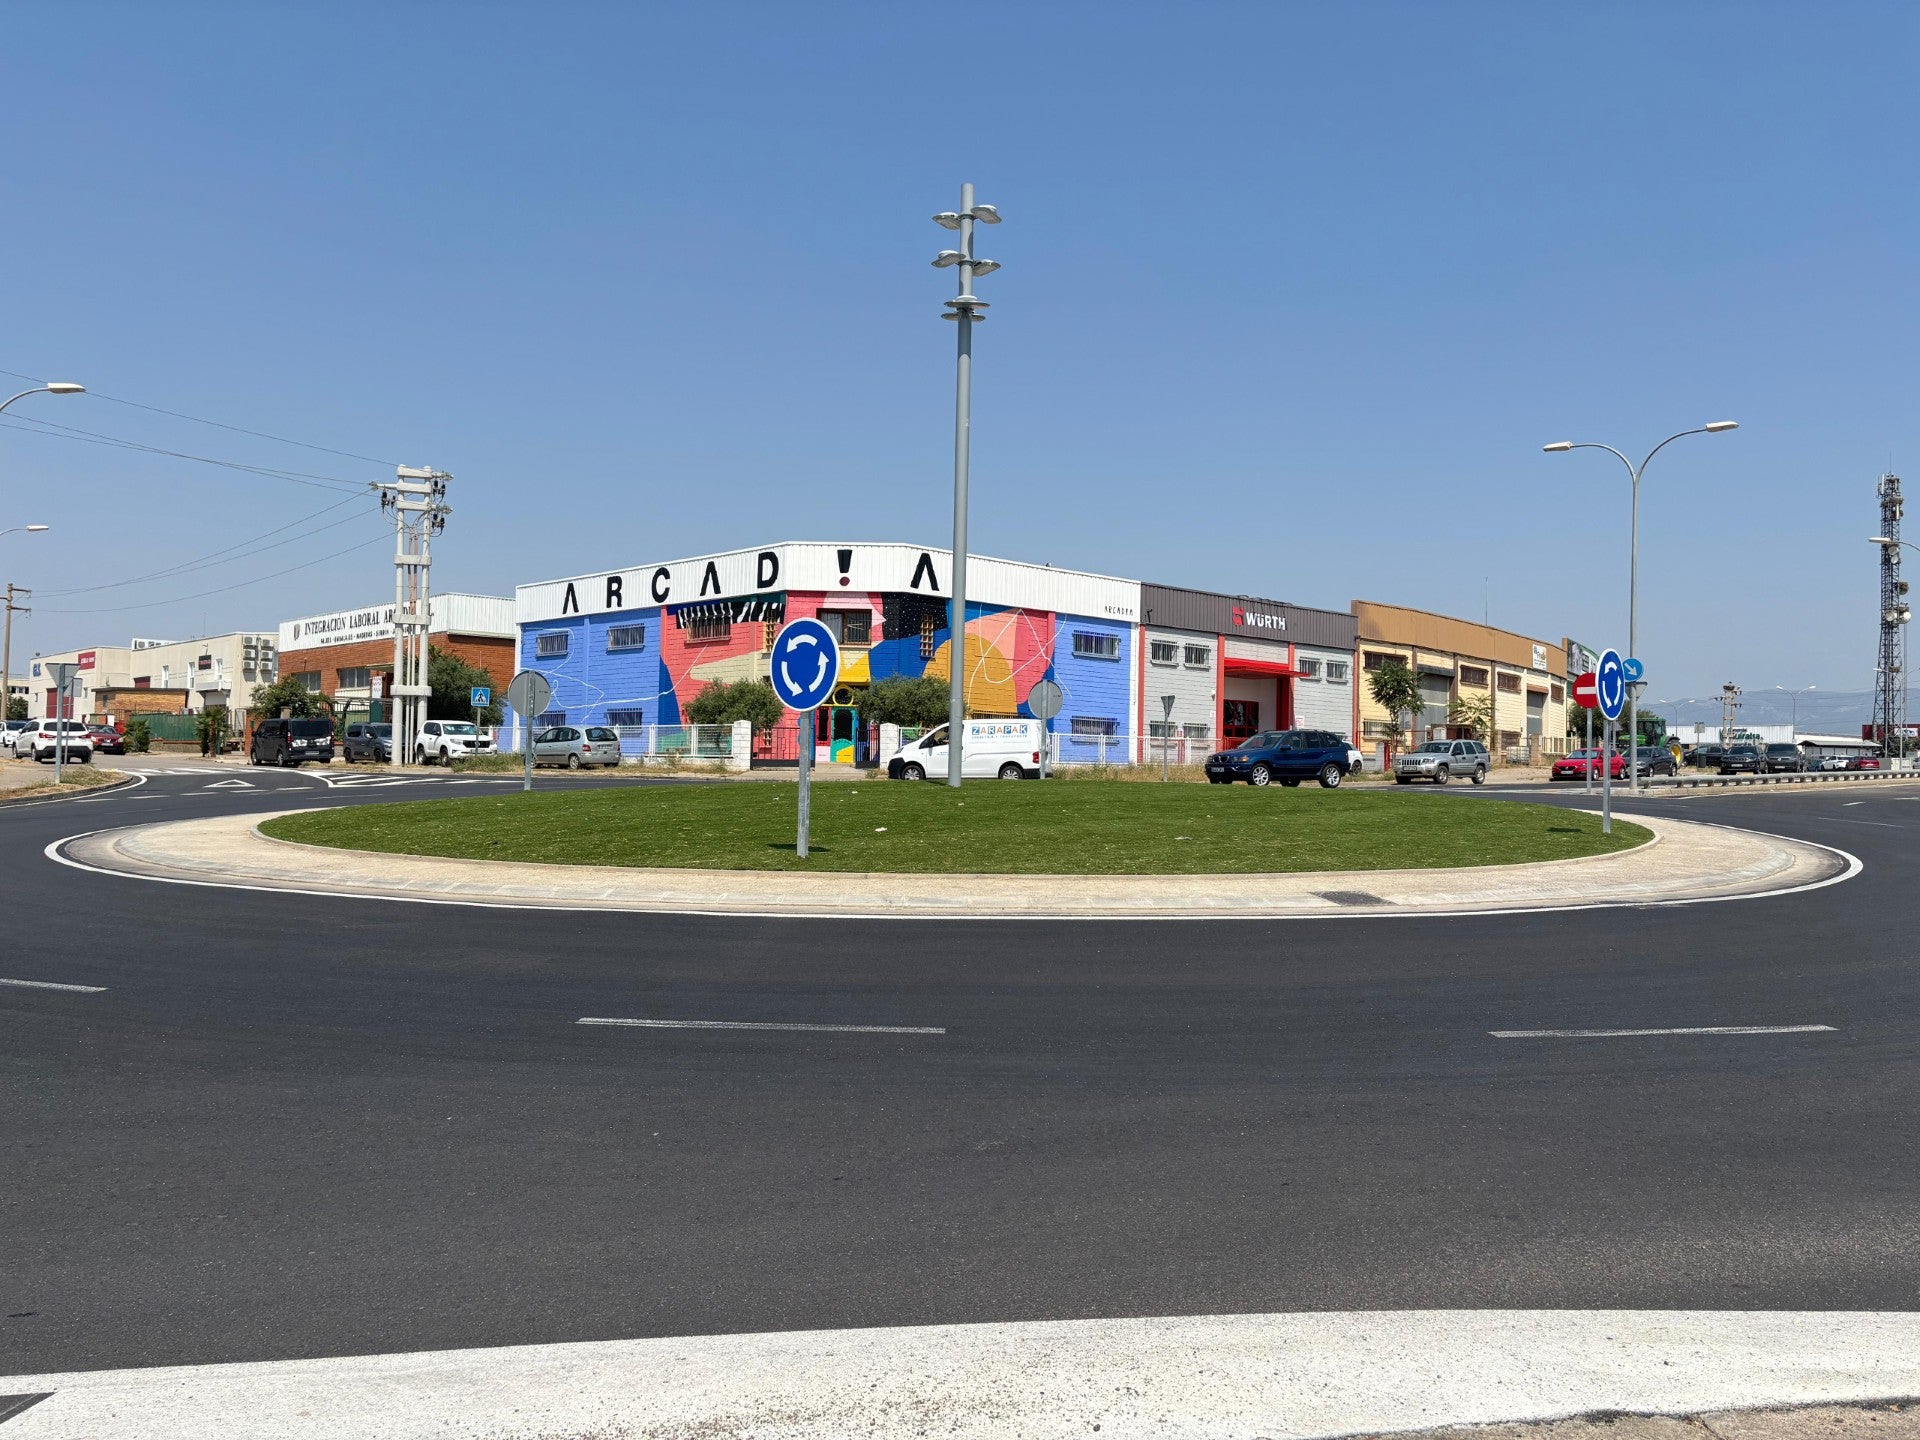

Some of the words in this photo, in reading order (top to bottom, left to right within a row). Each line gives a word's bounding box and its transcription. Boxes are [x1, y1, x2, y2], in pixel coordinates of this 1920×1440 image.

[304, 614, 347, 636] INTEGRACIÓN
[349, 610, 380, 629] LABORAL
[1245, 612, 1287, 631] WÜRTH
[972, 725, 1027, 735] ZARAPAK
